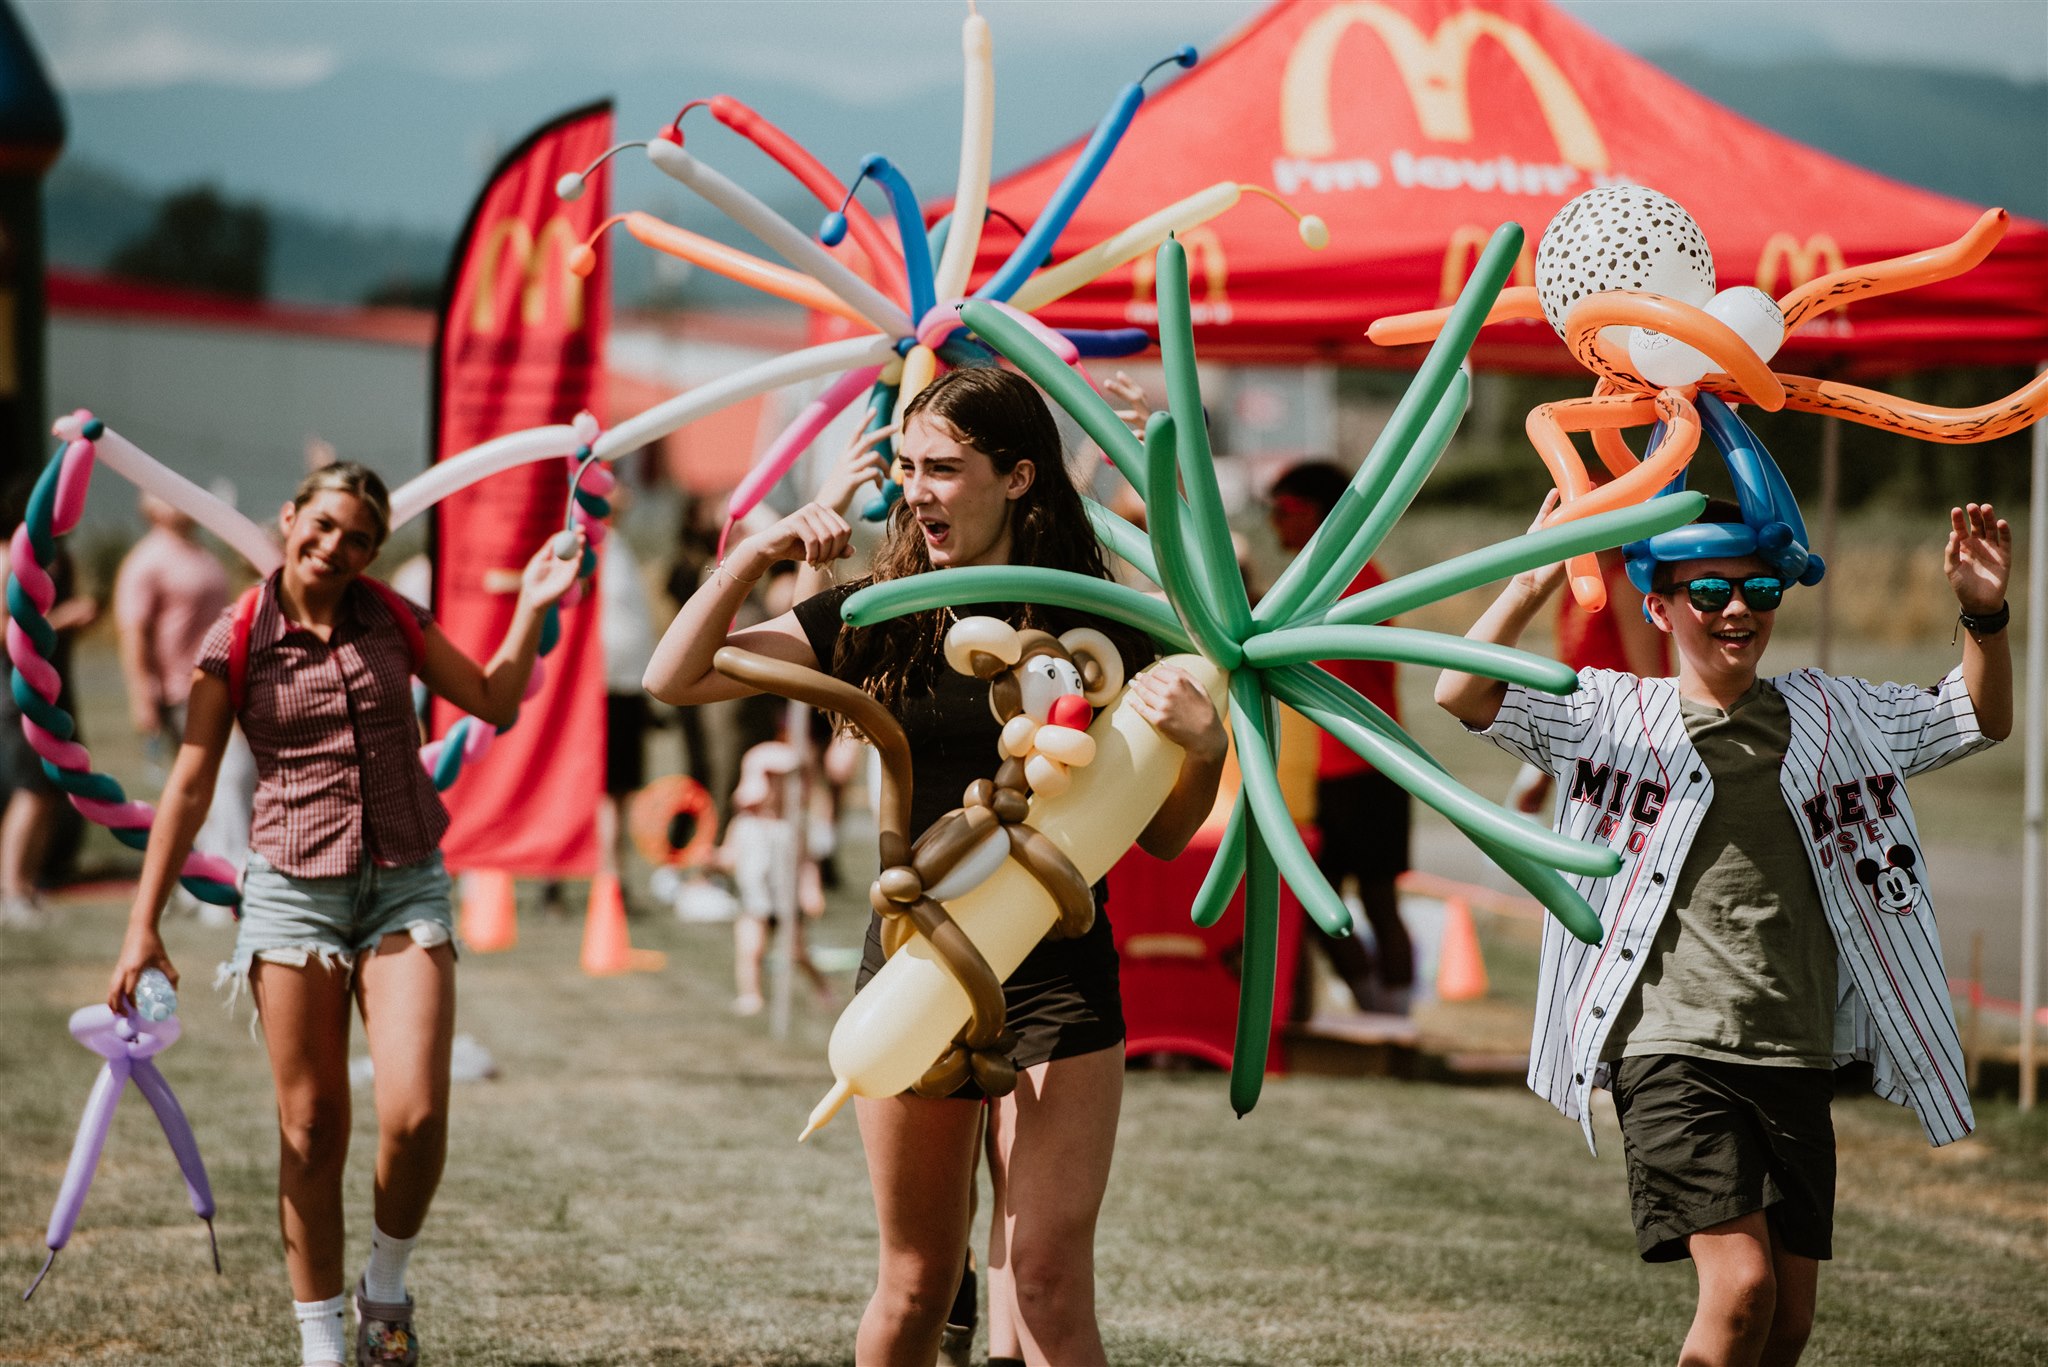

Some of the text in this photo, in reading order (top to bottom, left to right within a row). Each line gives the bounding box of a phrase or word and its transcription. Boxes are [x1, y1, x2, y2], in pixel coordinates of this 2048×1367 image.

[1281, 2, 1609, 170] M
[1570, 757, 1667, 828] MIC
[1802, 773, 1897, 843] KEY
[1594, 813, 1647, 854] MO
[1819, 818, 1884, 869] USE
